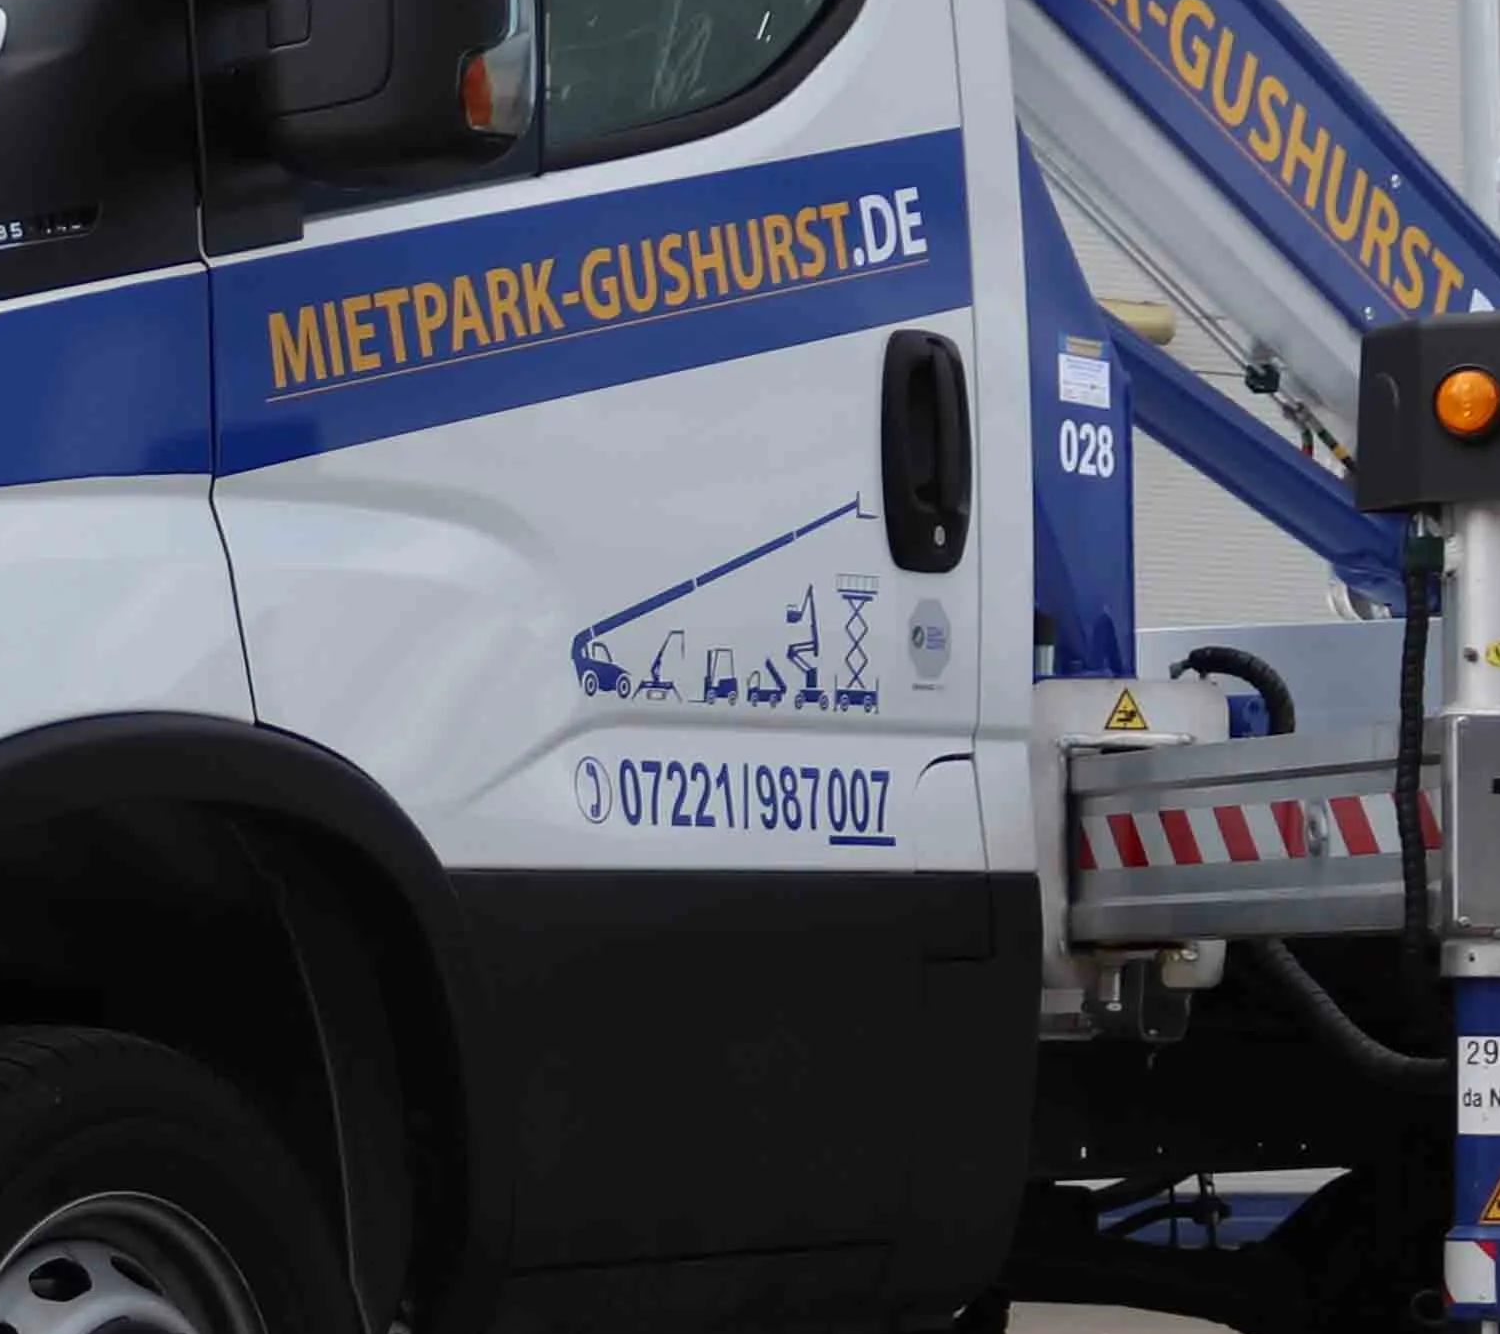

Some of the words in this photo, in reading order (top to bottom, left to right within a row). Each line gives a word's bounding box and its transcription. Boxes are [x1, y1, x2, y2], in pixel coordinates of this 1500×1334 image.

[267, 186, 927, 388] MIETPARK-GUSHURST.DE
[1060, 419, 1114, 479] 028
[1463, 1087, 1482, 1108] da
